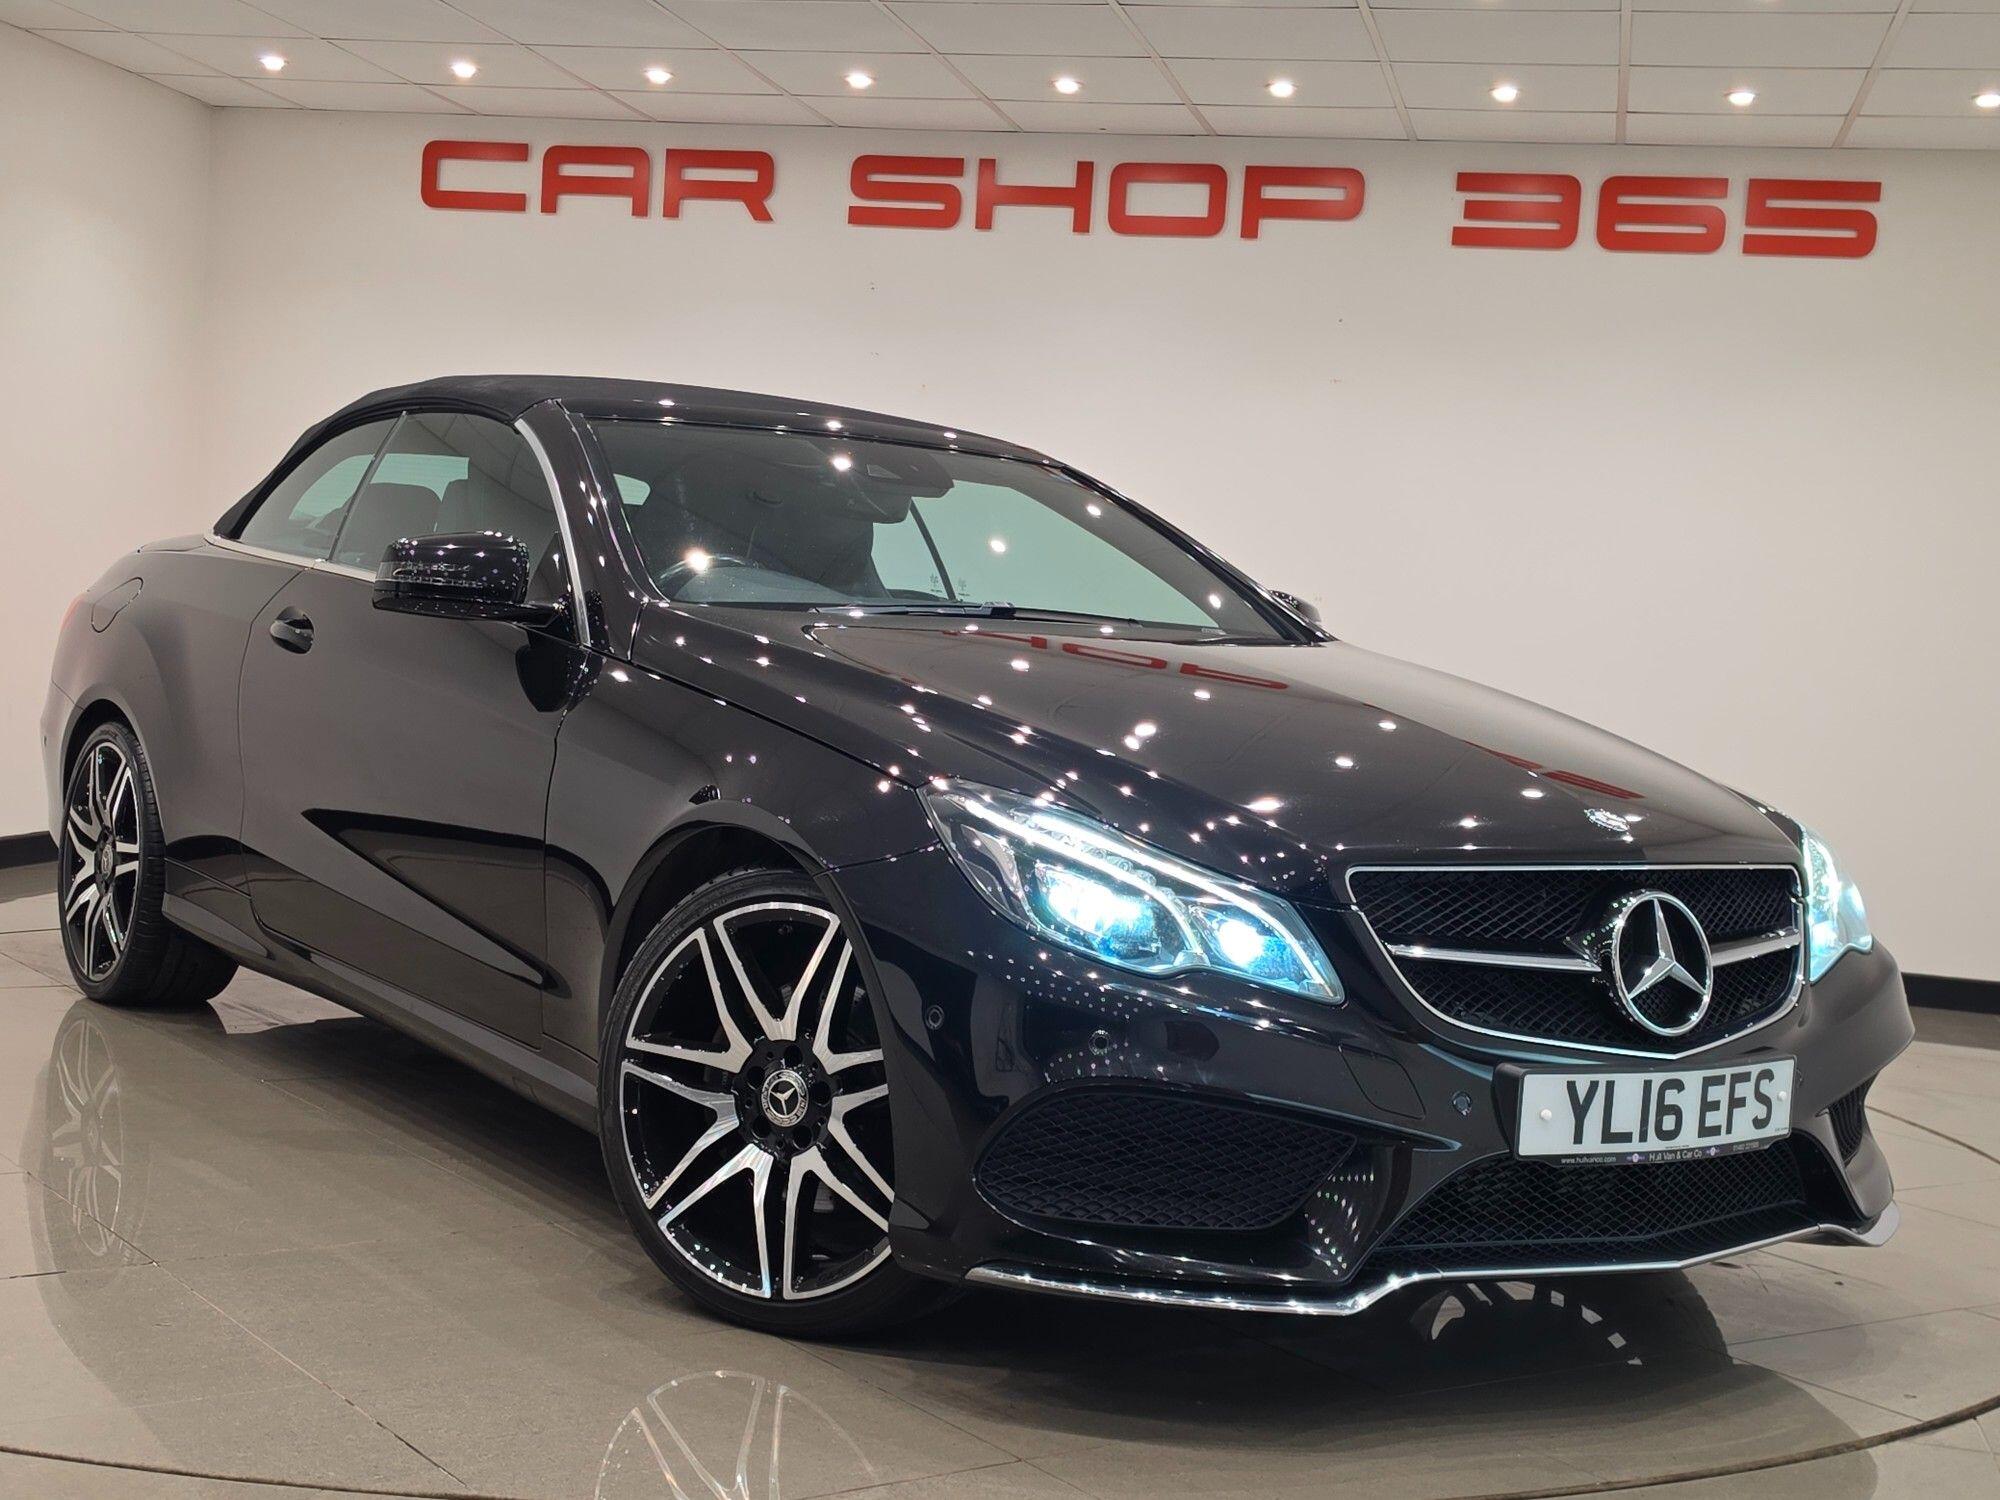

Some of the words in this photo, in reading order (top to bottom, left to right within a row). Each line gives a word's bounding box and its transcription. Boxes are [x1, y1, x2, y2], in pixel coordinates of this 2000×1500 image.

[421, 140, 775, 222] CAR
[848, 155, 1365, 239] SHOP
[1452, 172, 1881, 258] 365
[1566, 1078, 1686, 1145] YL16
[1698, 1069, 1776, 1139] EFS
[1682, 1150, 1694, 1159] Car
